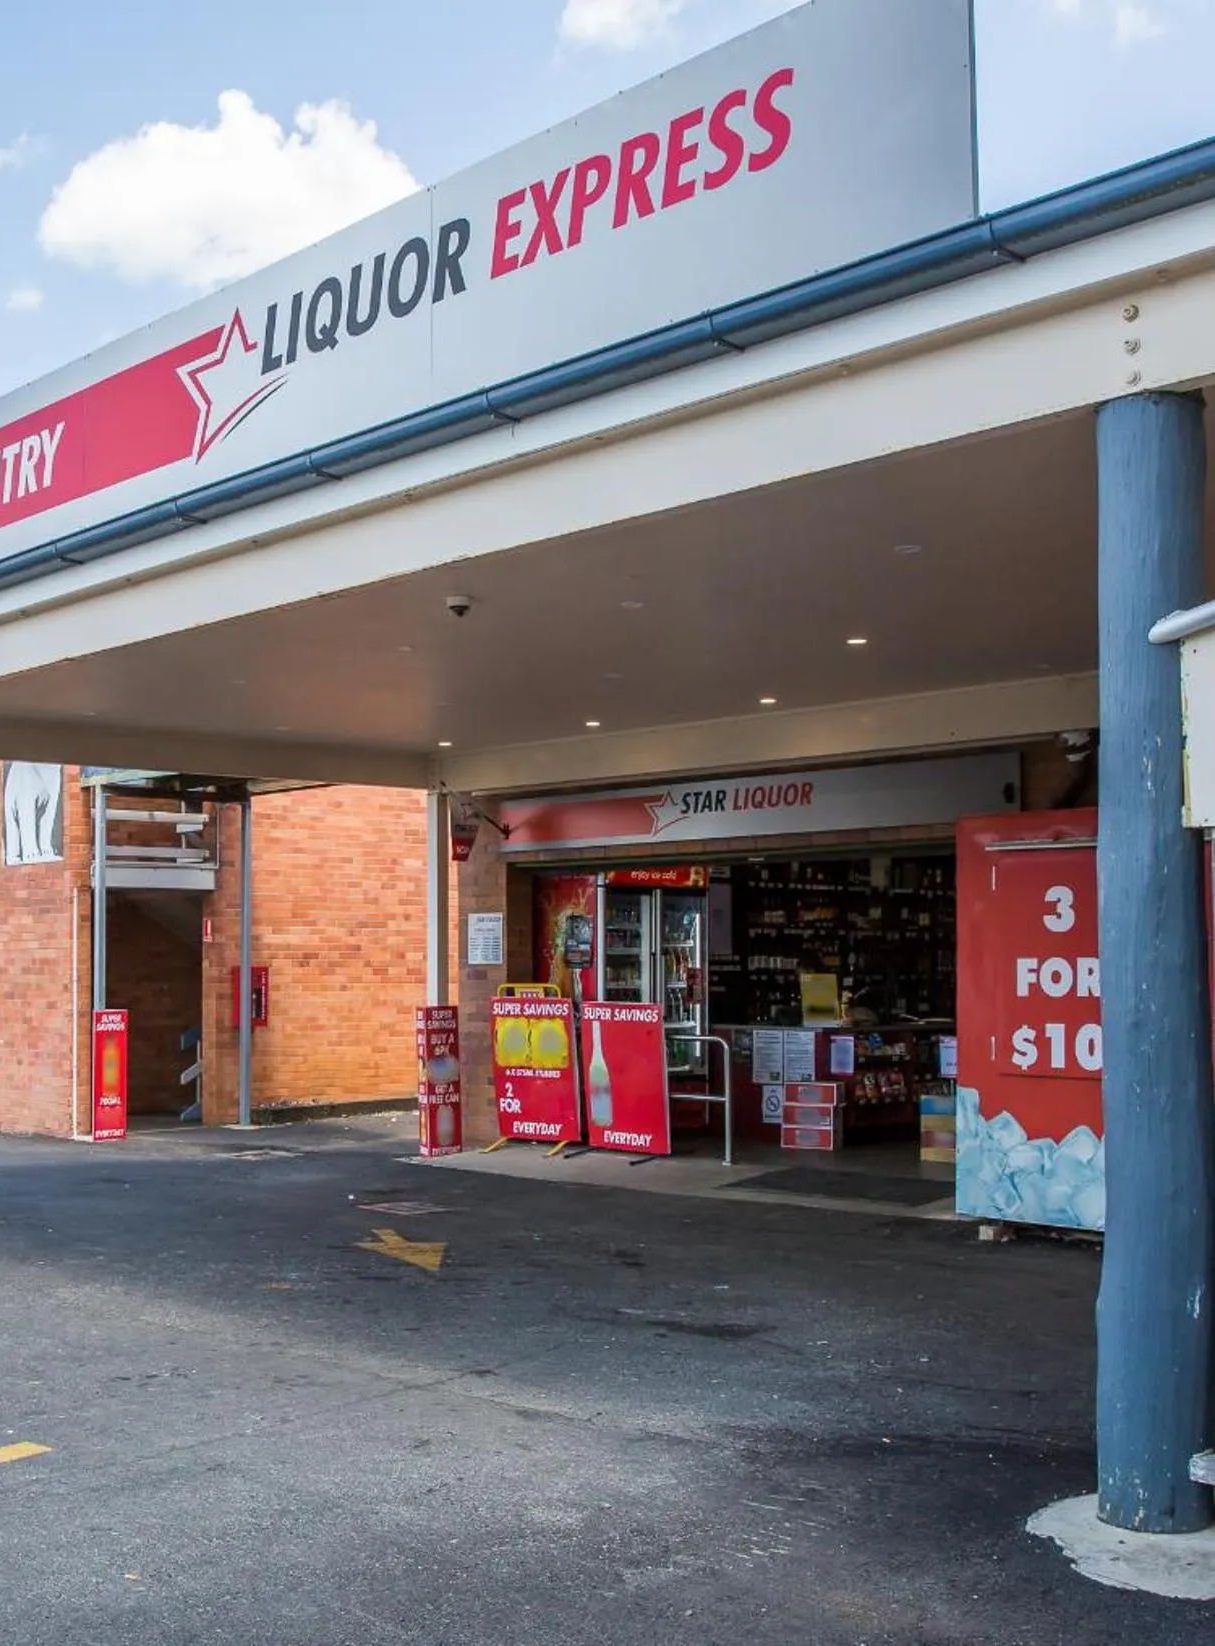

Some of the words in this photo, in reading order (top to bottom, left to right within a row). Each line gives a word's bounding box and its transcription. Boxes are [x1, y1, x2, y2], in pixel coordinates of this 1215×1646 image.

[261, 218, 471, 376] LIQUOR
[490, 67, 794, 280] EXPRESS
[680, 788, 726, 814] STAR
[731, 781, 814, 810] LIQUOR
[1043, 886, 1075, 933] 3
[1016, 957, 1101, 998] FOR
[492, 1003, 521, 1016] SUPER
[523, 1003, 569, 1016] SAVINGS
[583, 1007, 611, 1021] SUPER
[613, 1009, 659, 1023] SAVINGS
[430, 1034, 447, 1044] BUY
[1011, 1023, 1104, 1071] $10
[505, 1082, 514, 1098] 2
[499, 1098, 522, 1114] FOR
[513, 1121, 563, 1136] EVERYDAY
[603, 1130, 653, 1147] EVERYDAY
